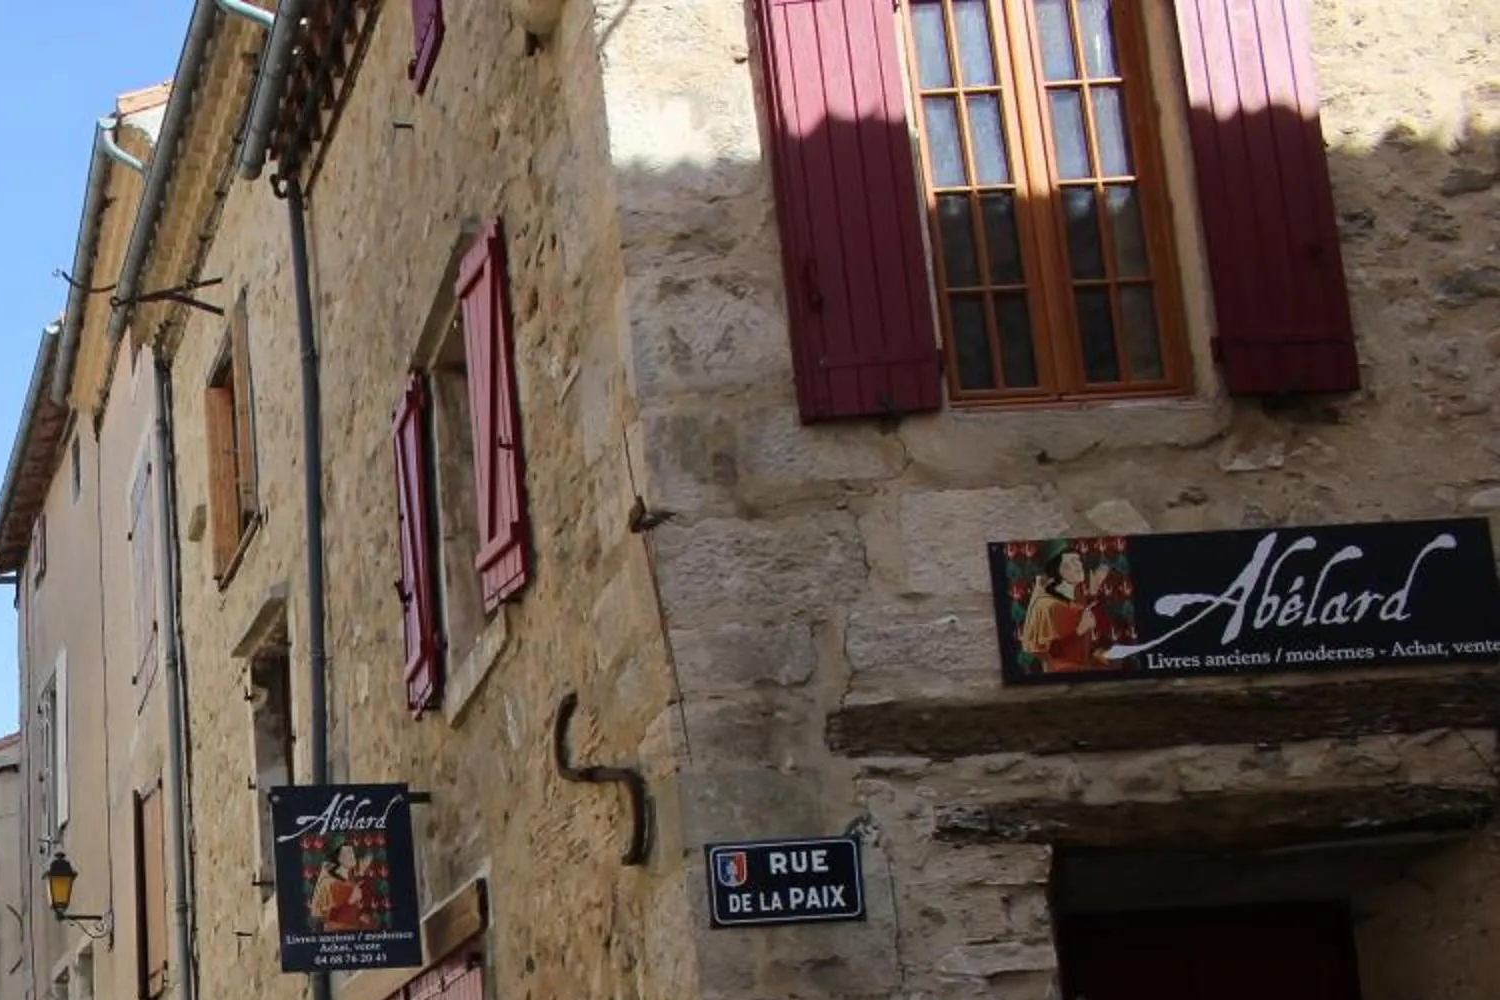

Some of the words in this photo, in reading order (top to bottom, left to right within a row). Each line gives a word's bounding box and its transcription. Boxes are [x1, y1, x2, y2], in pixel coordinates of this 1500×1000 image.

[1104, 531, 1457, 659] Abélard
[1146, 651, 1200, 669] Livres
[1205, 647, 1271, 667] anciens
[1274, 646, 1284, 664] /
[1285, 642, 1375, 662] modernes
[1391, 640, 1450, 657] Achat,
[276, 792, 404, 843] Abélard
[769, 849, 829, 875] RUE
[728, 893, 753, 914] DE
[759, 891, 784, 911] LA
[788, 884, 847, 911] PAIX
